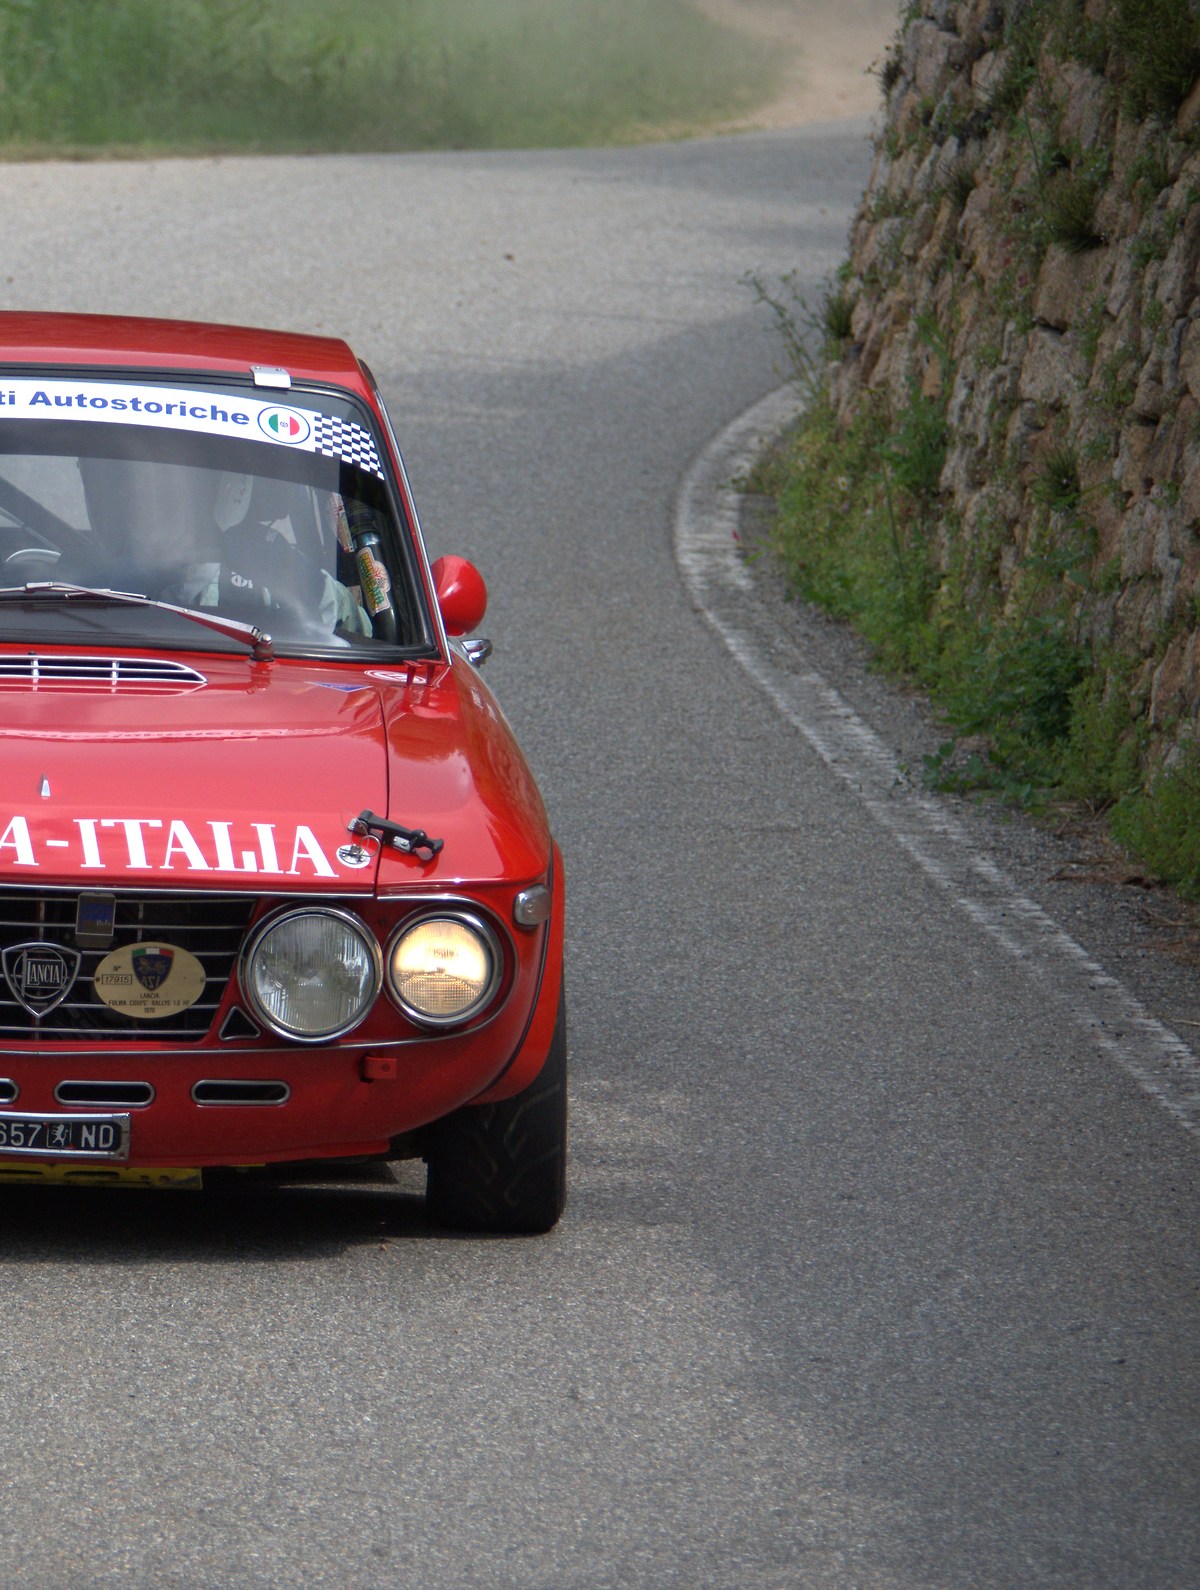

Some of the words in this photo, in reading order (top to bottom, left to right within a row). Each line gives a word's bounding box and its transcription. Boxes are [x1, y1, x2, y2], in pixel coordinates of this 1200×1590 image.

[29, 391, 250, 425] Autostoriche
[26, 960, 60, 987] LANCIA
[80, 1124, 114, 1148] ND
